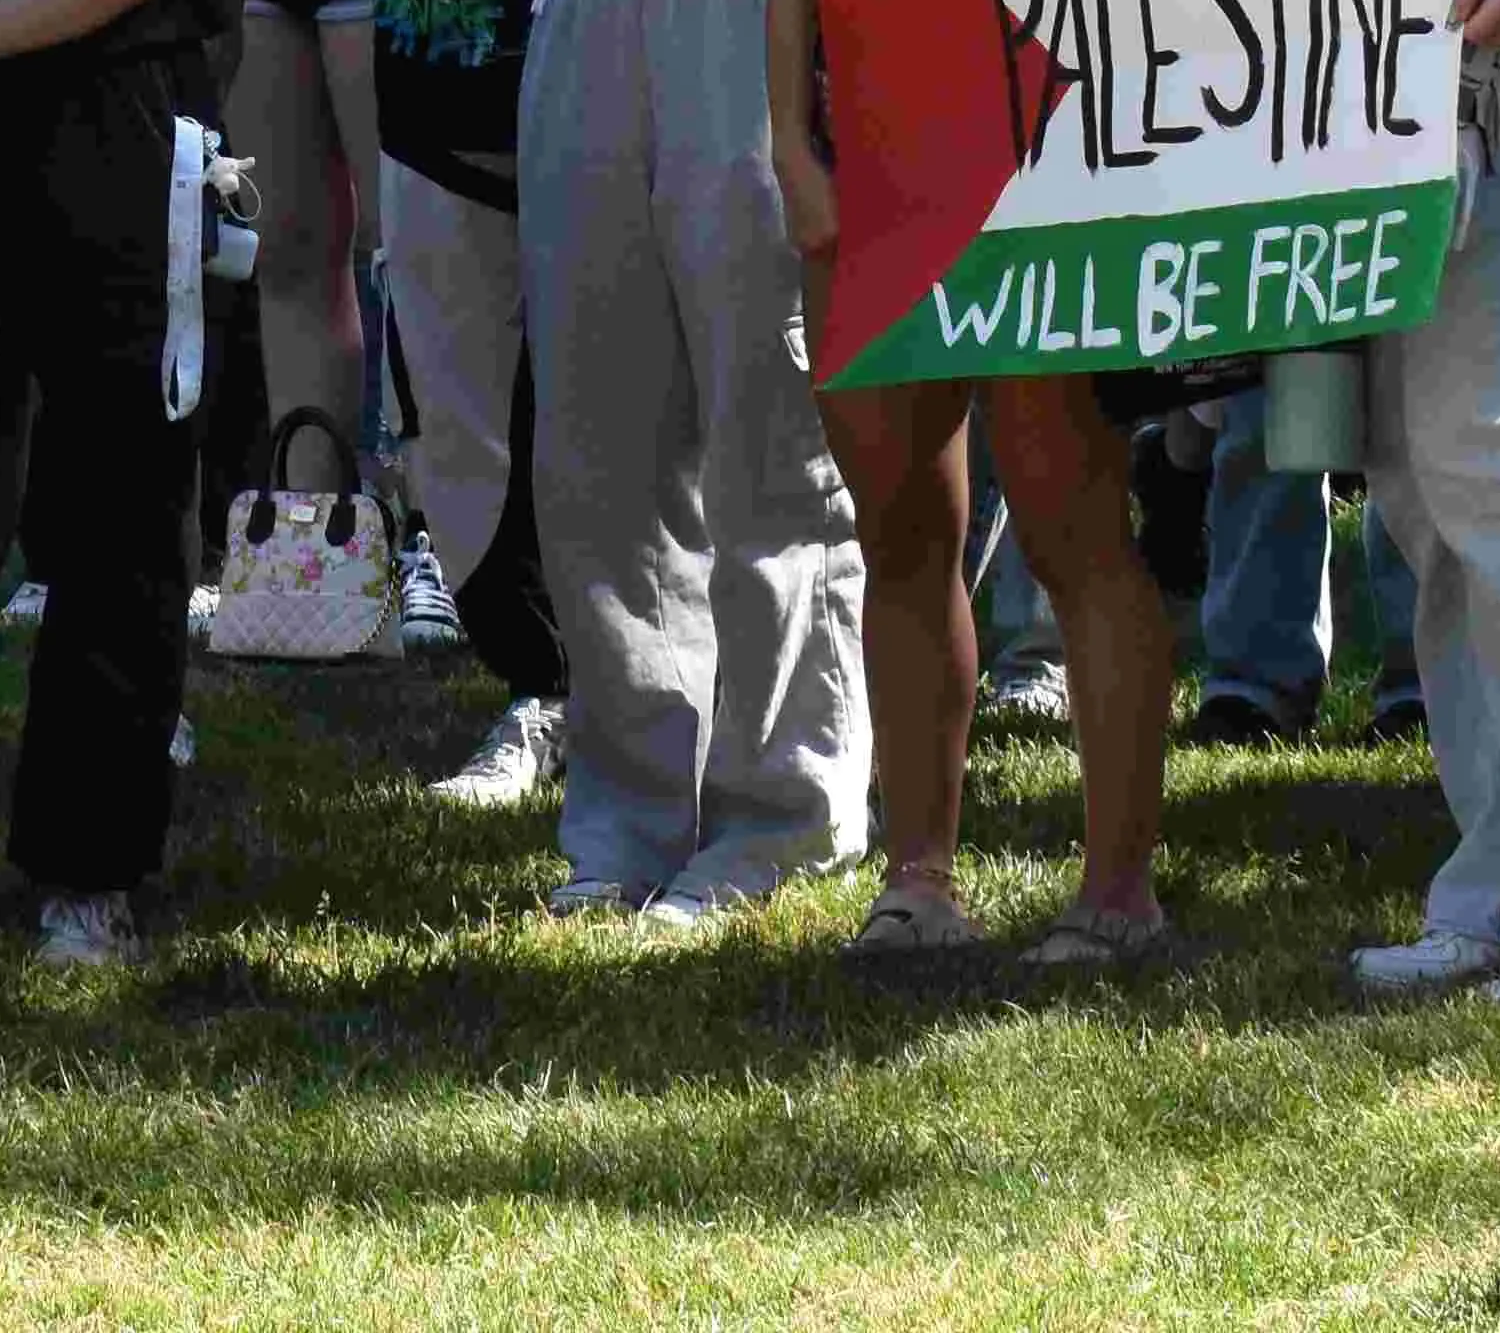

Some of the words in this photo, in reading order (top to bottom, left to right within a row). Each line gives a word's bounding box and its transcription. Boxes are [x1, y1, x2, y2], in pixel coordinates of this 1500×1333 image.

[931, 255, 1121, 352] WILL
[1136, 239, 1224, 358] BE
[1246, 209, 1409, 332] FREE
